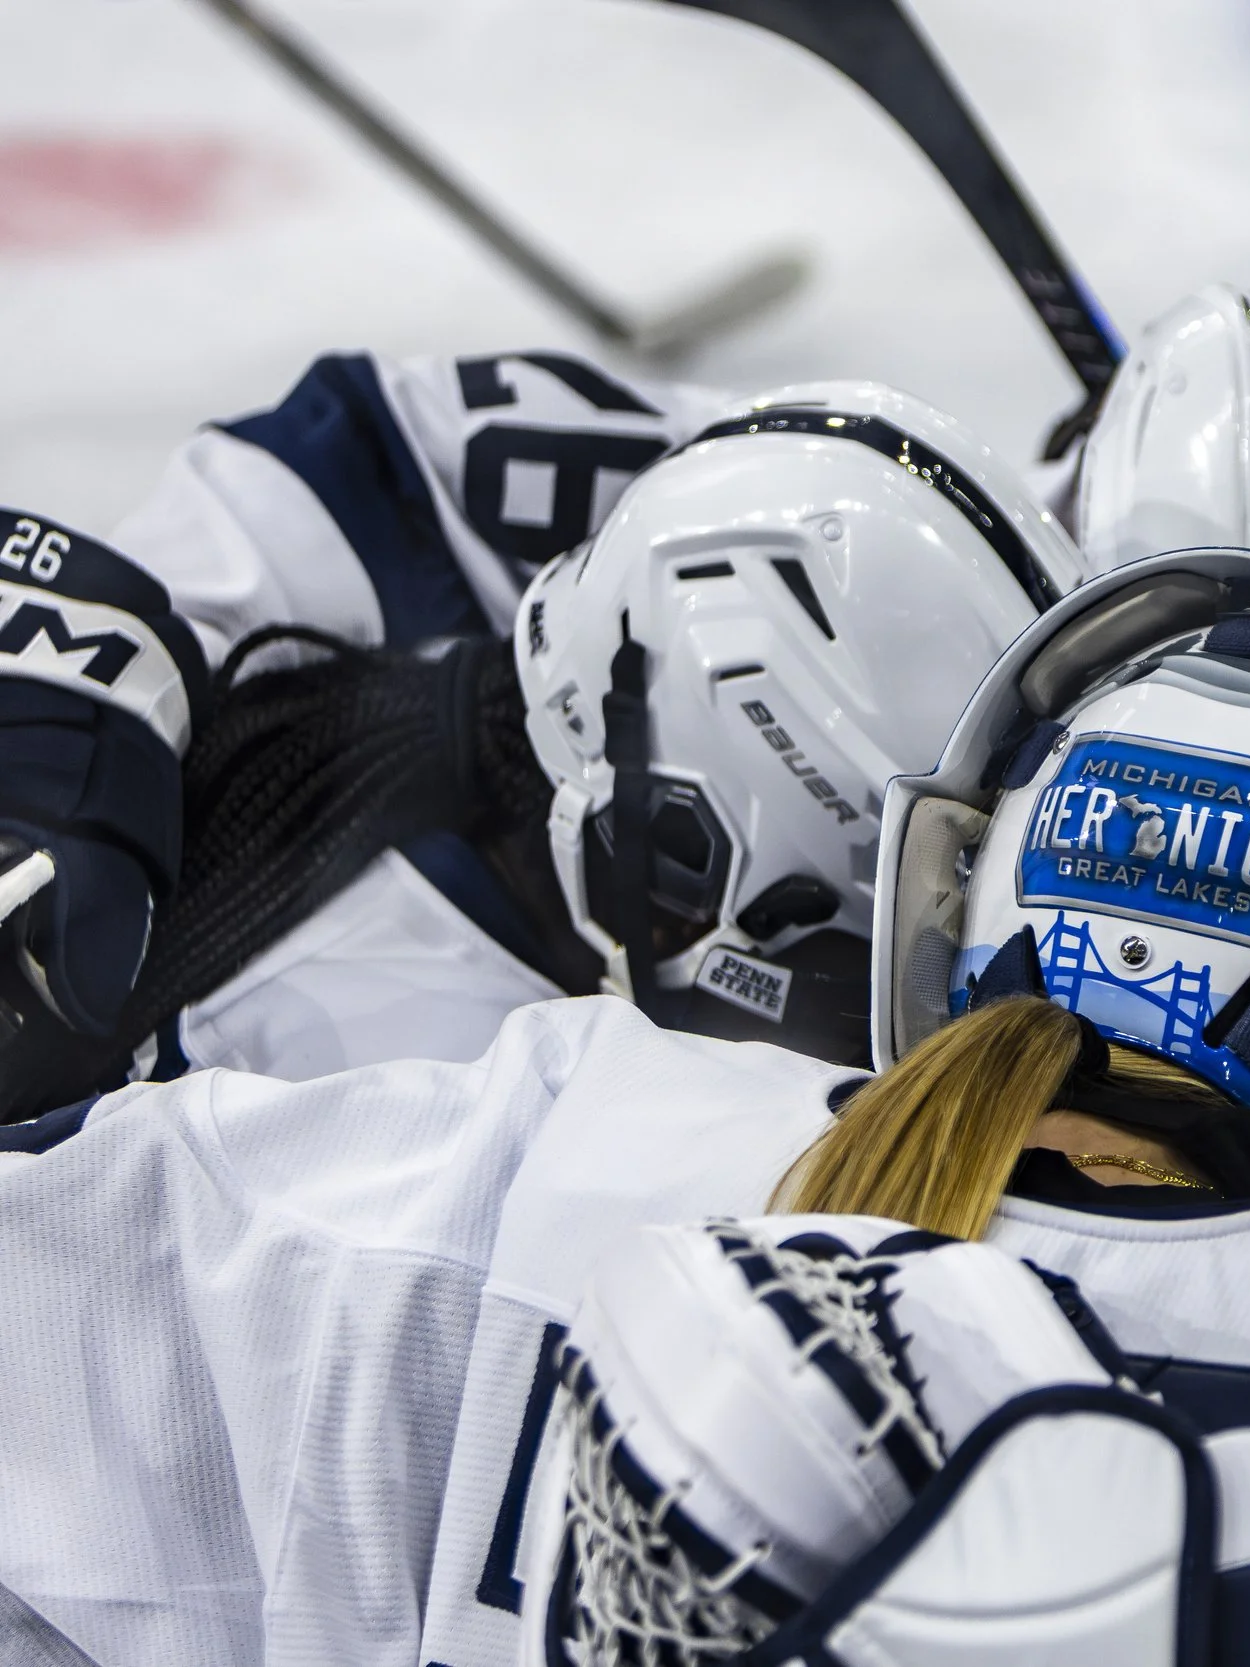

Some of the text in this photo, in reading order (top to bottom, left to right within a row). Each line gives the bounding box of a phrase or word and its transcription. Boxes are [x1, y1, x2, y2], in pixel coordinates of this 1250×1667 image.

[0, 517, 71, 583] 26
[740, 699, 860, 826] BAUER
[1057, 856, 1147, 887] GREAT
[709, 966, 782, 1010] STATE
[721, 954, 783, 993] PENN
